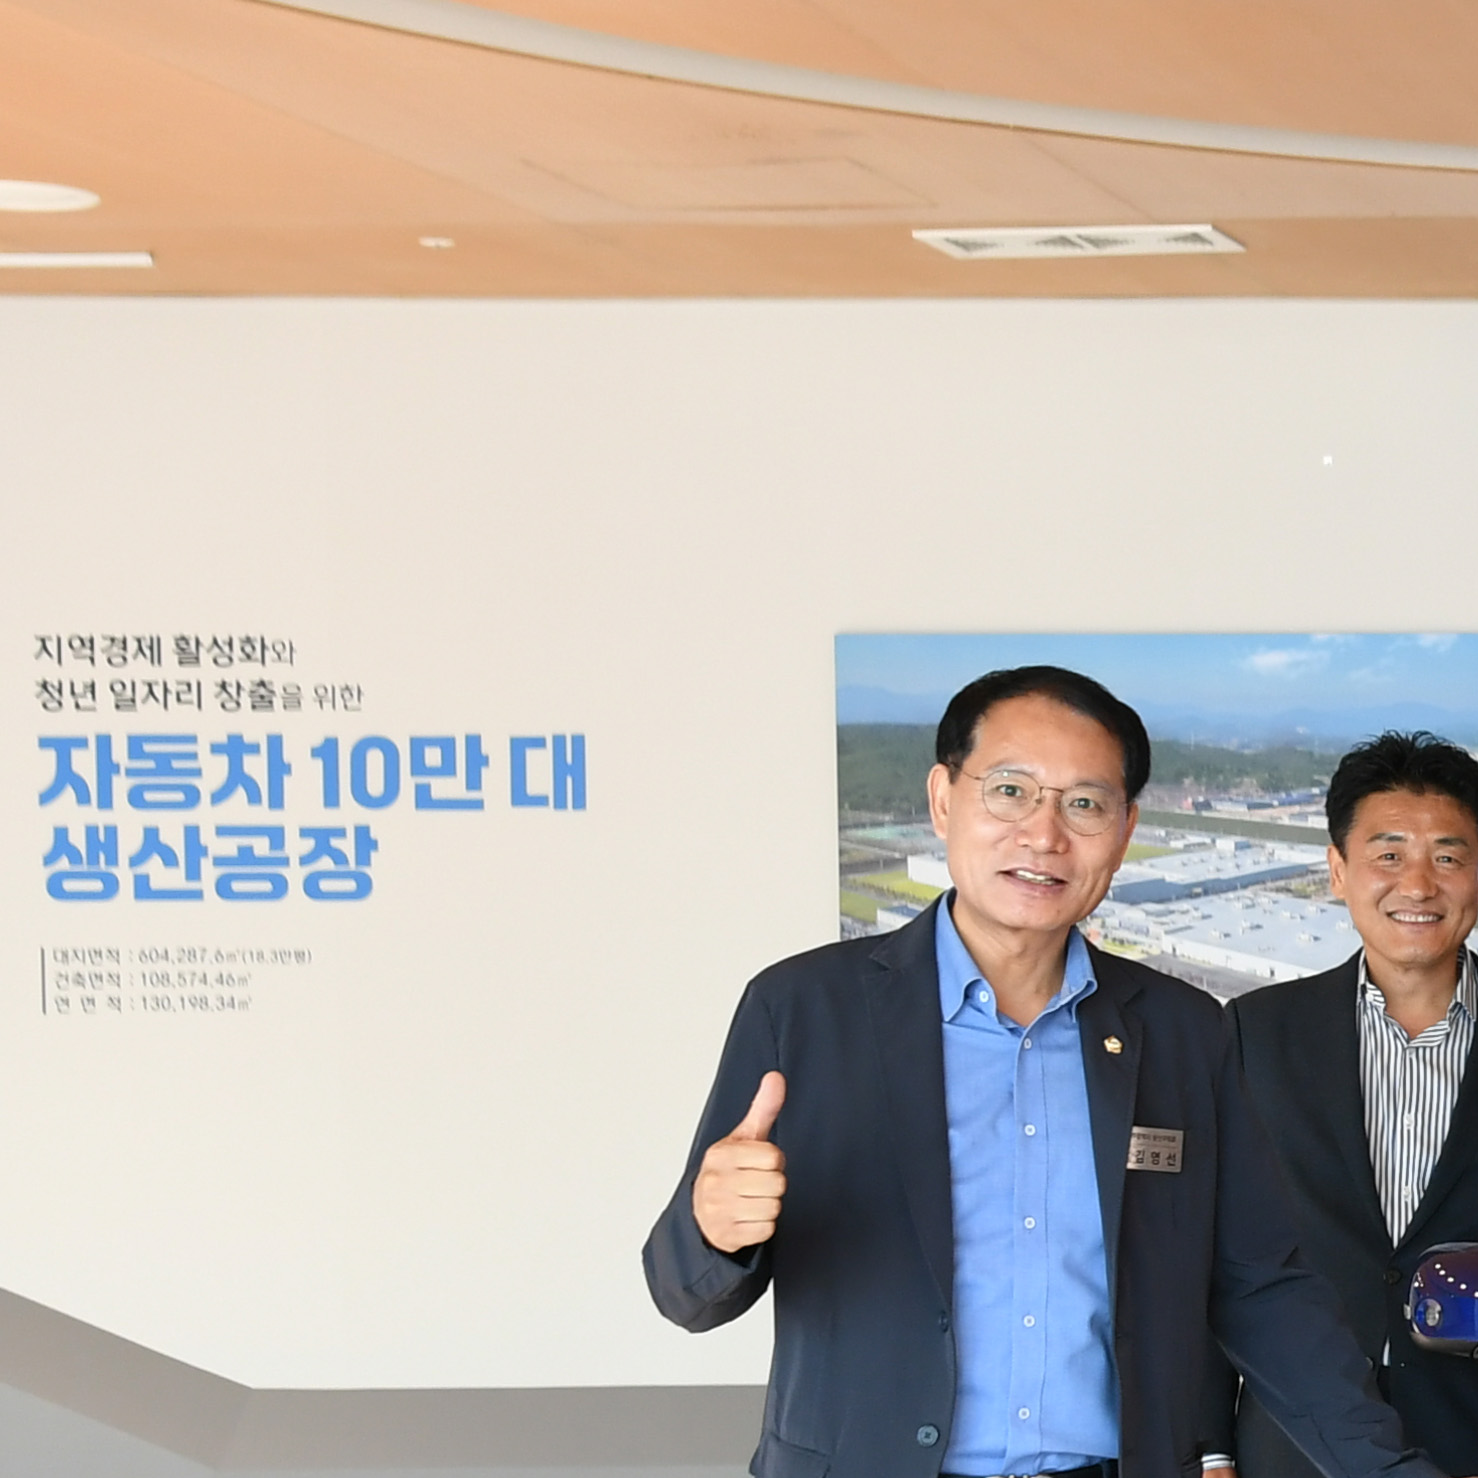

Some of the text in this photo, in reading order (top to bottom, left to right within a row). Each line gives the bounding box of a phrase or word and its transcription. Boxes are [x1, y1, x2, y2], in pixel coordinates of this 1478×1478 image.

[33, 632, 297, 668] 지역경제 활성화와
[33, 677, 366, 713] 청년 일자리 창출을 위한
[37, 732, 588, 812] 자동차 10만 대
[42, 823, 380, 903] 생산공장
